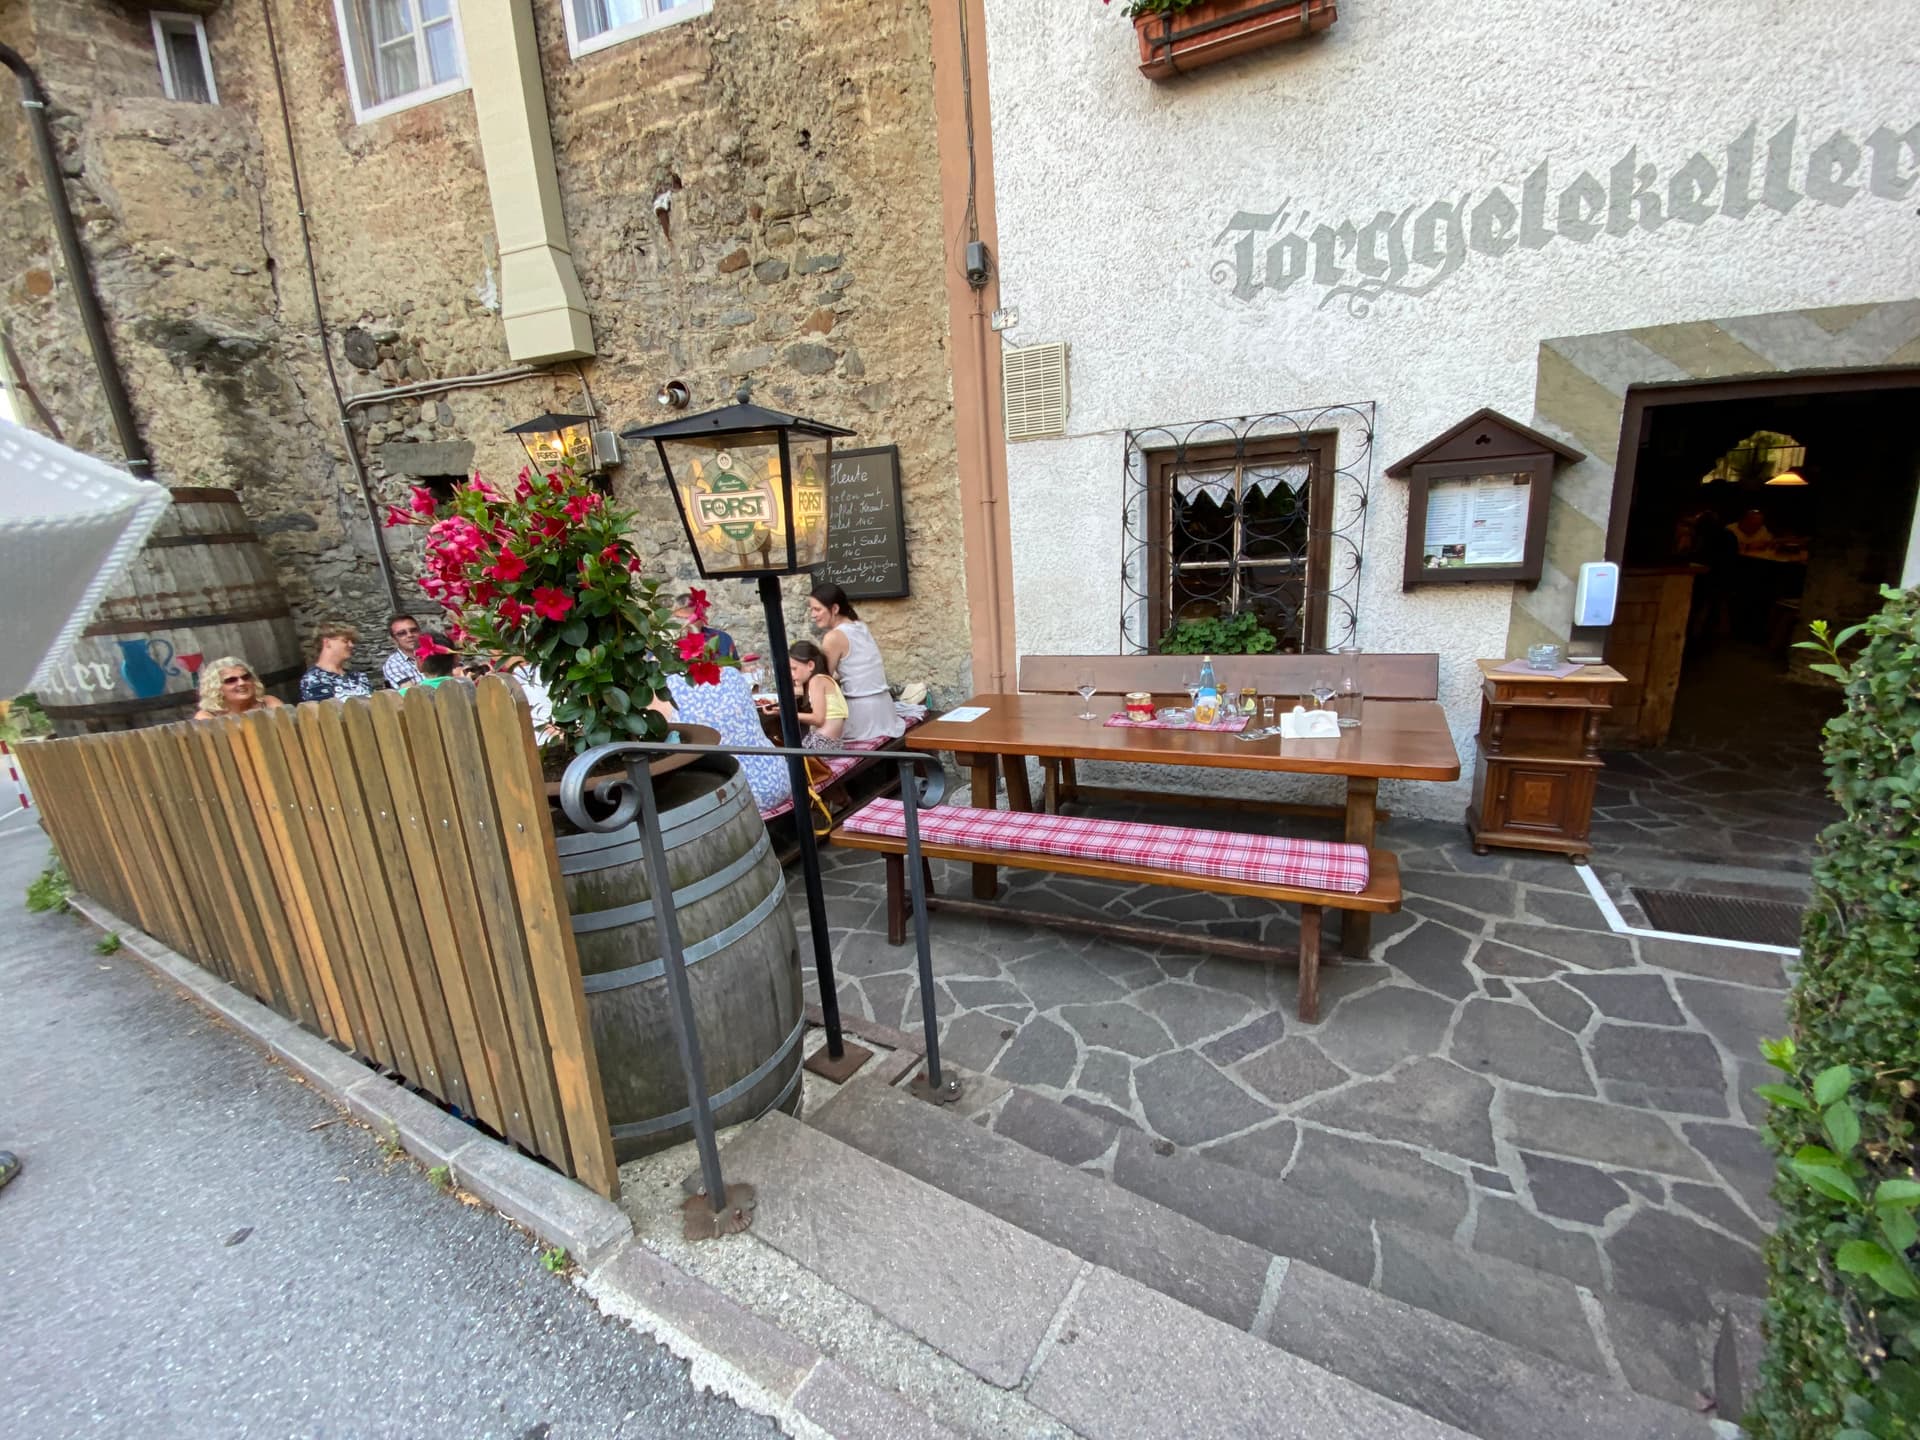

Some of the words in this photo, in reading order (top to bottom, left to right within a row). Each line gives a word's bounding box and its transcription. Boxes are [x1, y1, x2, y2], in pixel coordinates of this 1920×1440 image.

[1209, 115, 1920, 319] Törggelekeller
[831, 462, 868, 487] Heute
[700, 496, 765, 520] FORST
[798, 490, 822, 512] FORST
